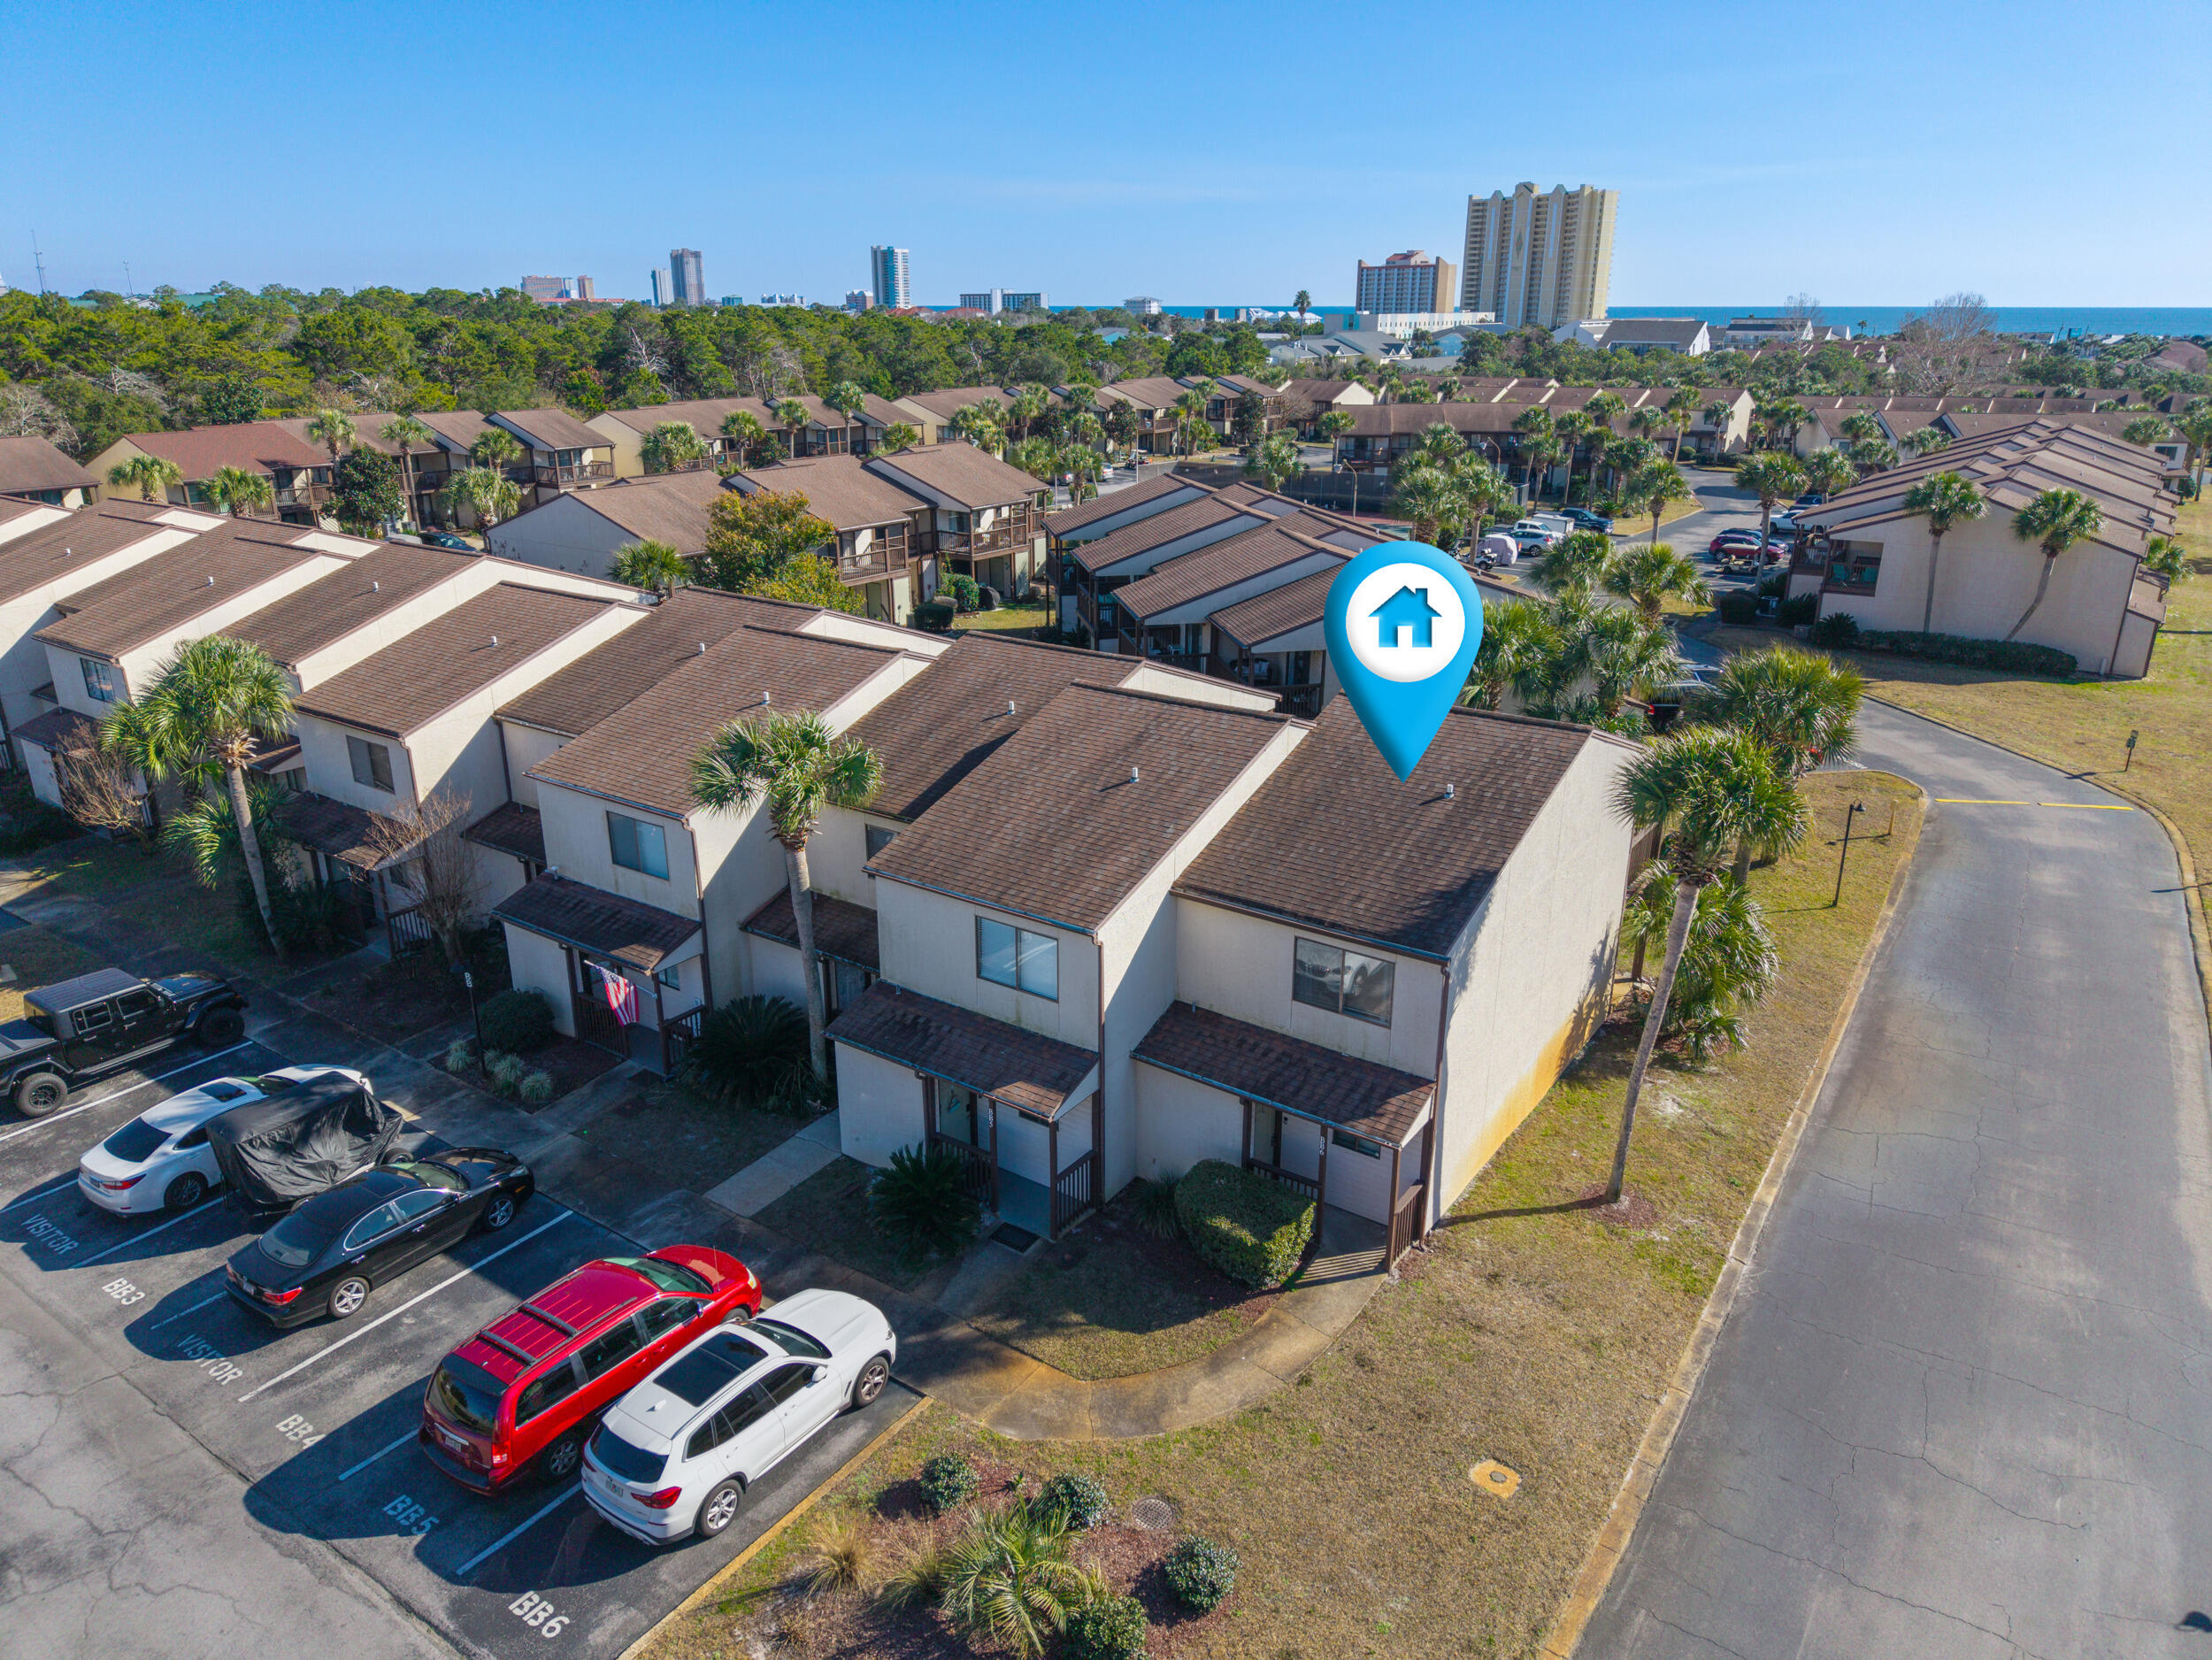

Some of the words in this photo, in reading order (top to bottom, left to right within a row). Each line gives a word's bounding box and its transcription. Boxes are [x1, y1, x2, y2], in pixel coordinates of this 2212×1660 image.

[21, 1213, 79, 1255] VISITOR
[102, 1277, 146, 1305] BB3
[177, 1333, 243, 1385] VISITOR
[275, 1413, 326, 1449] BB4
[382, 1495, 439, 1535] BB5
[508, 1590, 570, 1638] BB6
